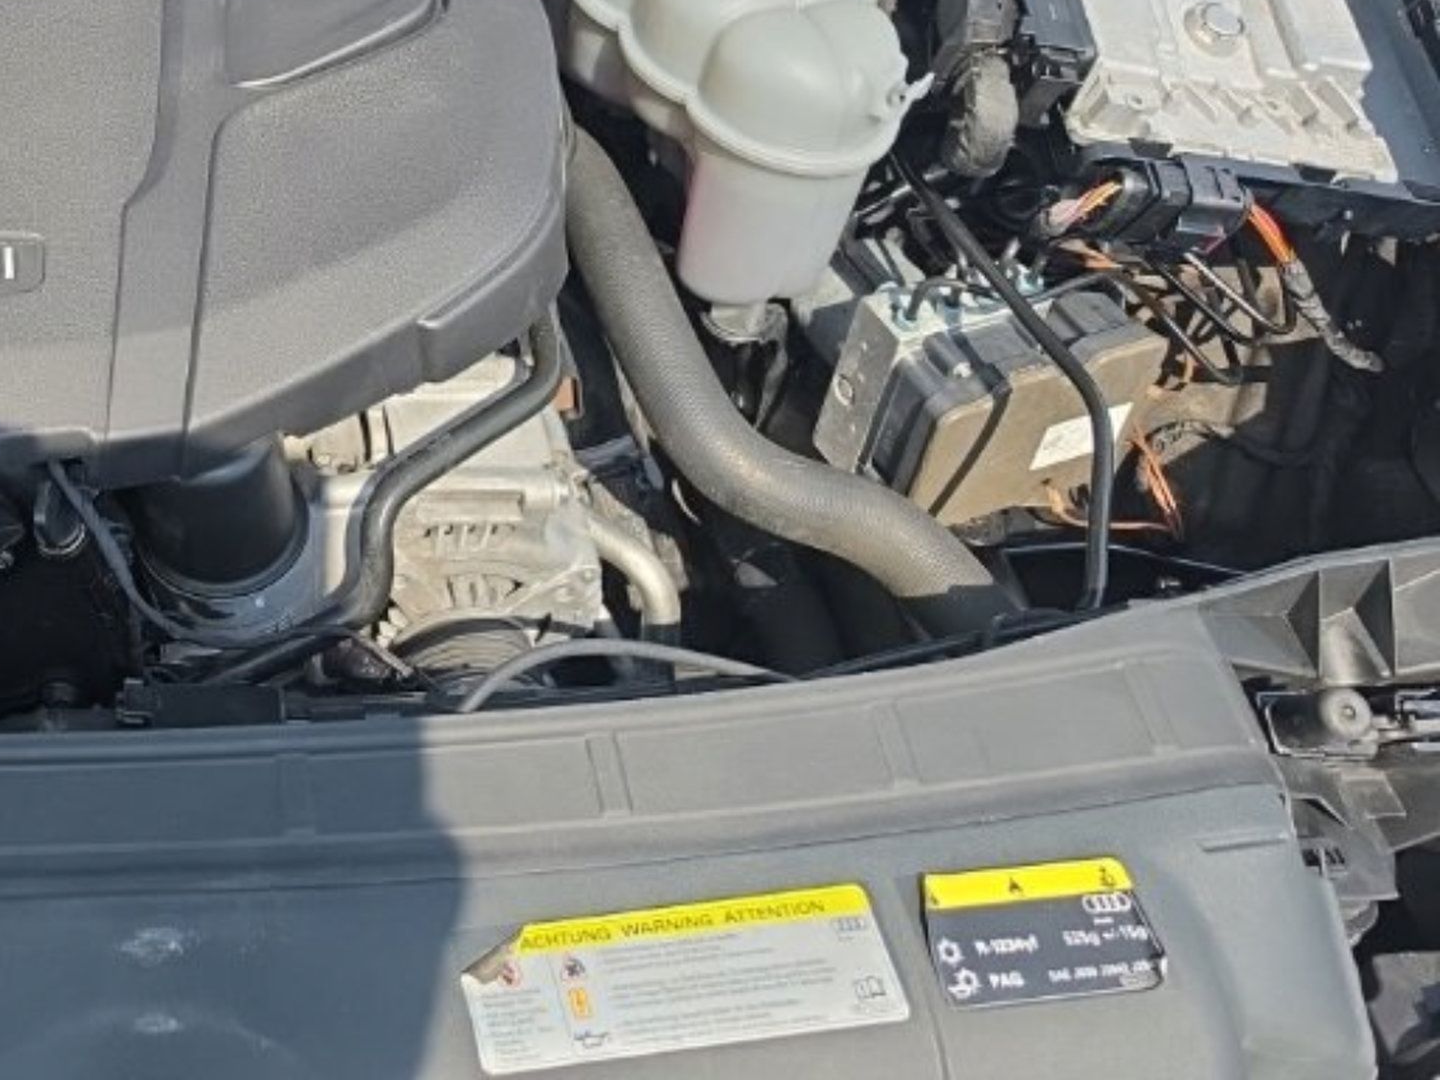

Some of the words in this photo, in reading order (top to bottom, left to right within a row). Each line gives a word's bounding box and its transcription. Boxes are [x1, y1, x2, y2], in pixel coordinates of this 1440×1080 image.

[521, 928, 611, 949] ACHTUNG
[621, 913, 714, 937] WARNING
[724, 899, 826, 924] ATTENTION
[988, 970, 1025, 990] PAG
